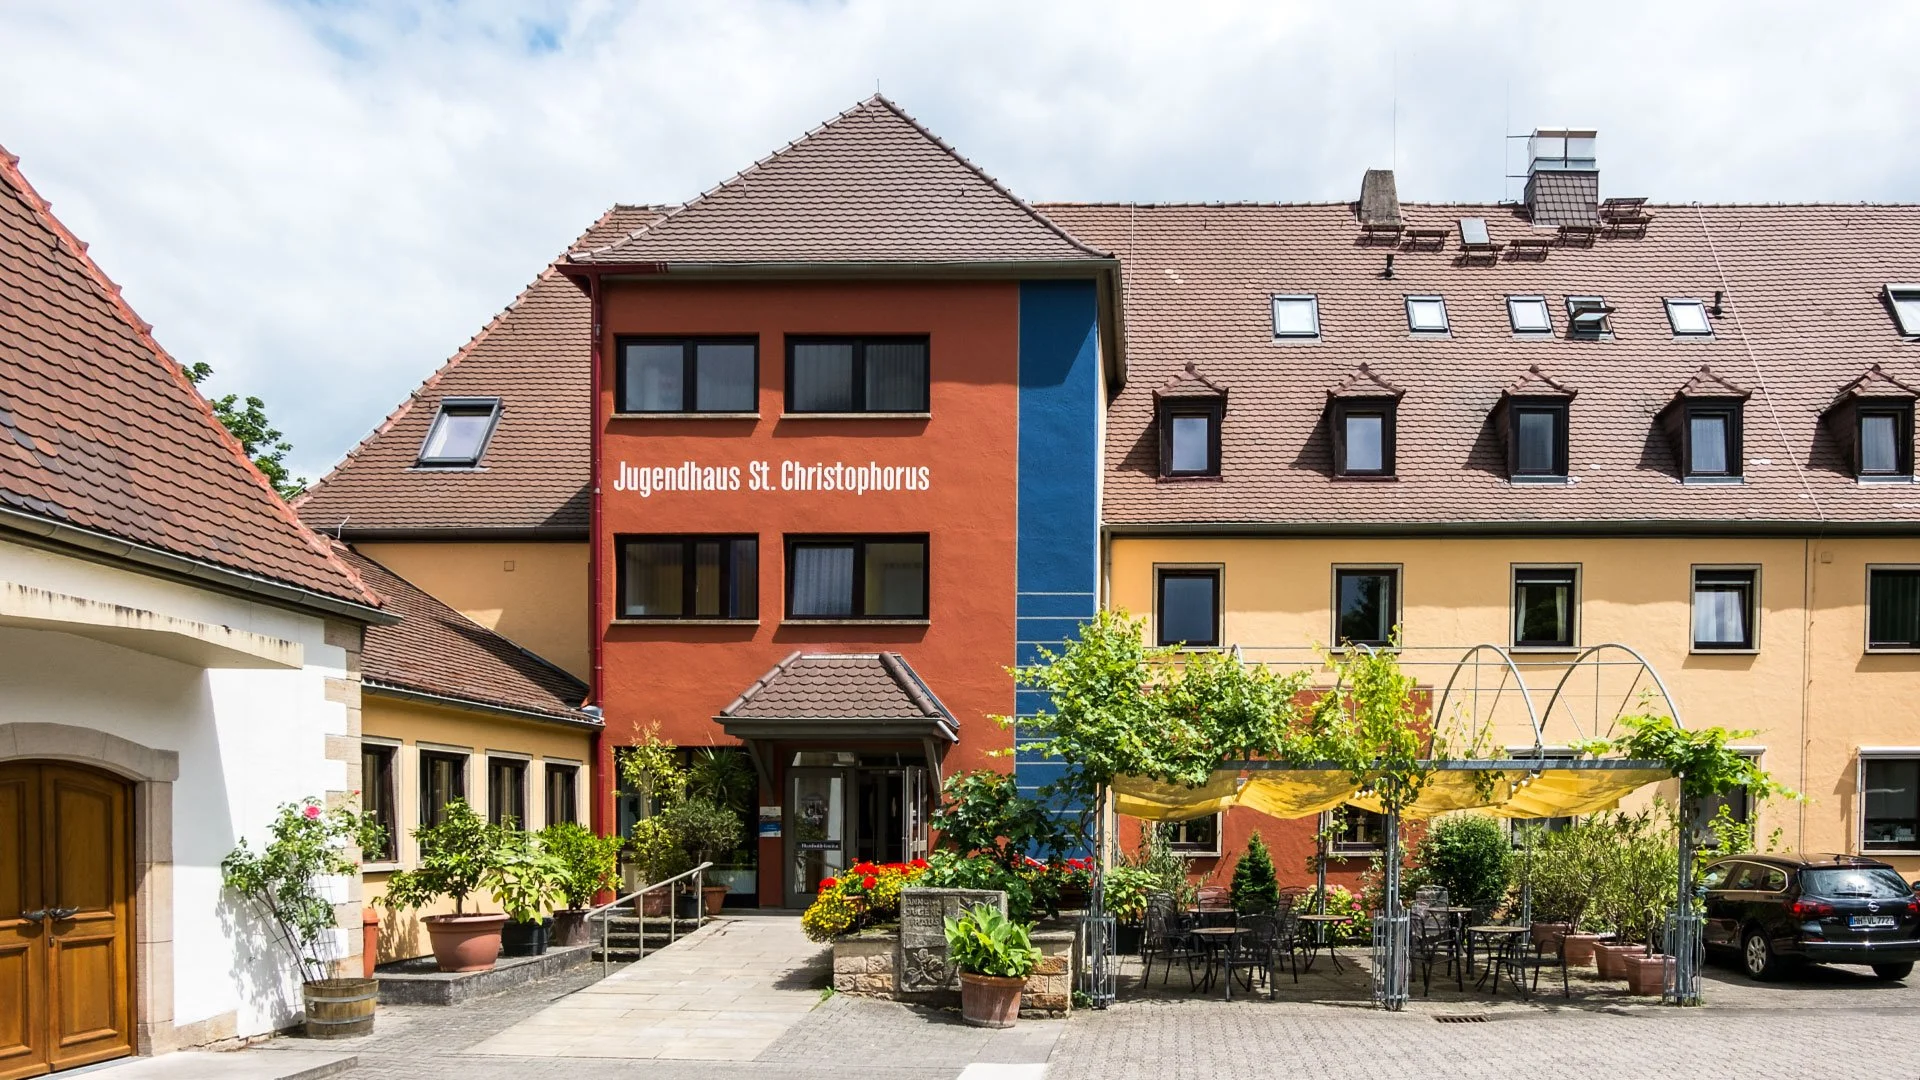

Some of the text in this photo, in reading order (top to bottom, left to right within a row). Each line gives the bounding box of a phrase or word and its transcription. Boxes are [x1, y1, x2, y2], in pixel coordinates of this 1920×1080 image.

[613, 460, 929, 497] Jugendhaus St. Christophorus
